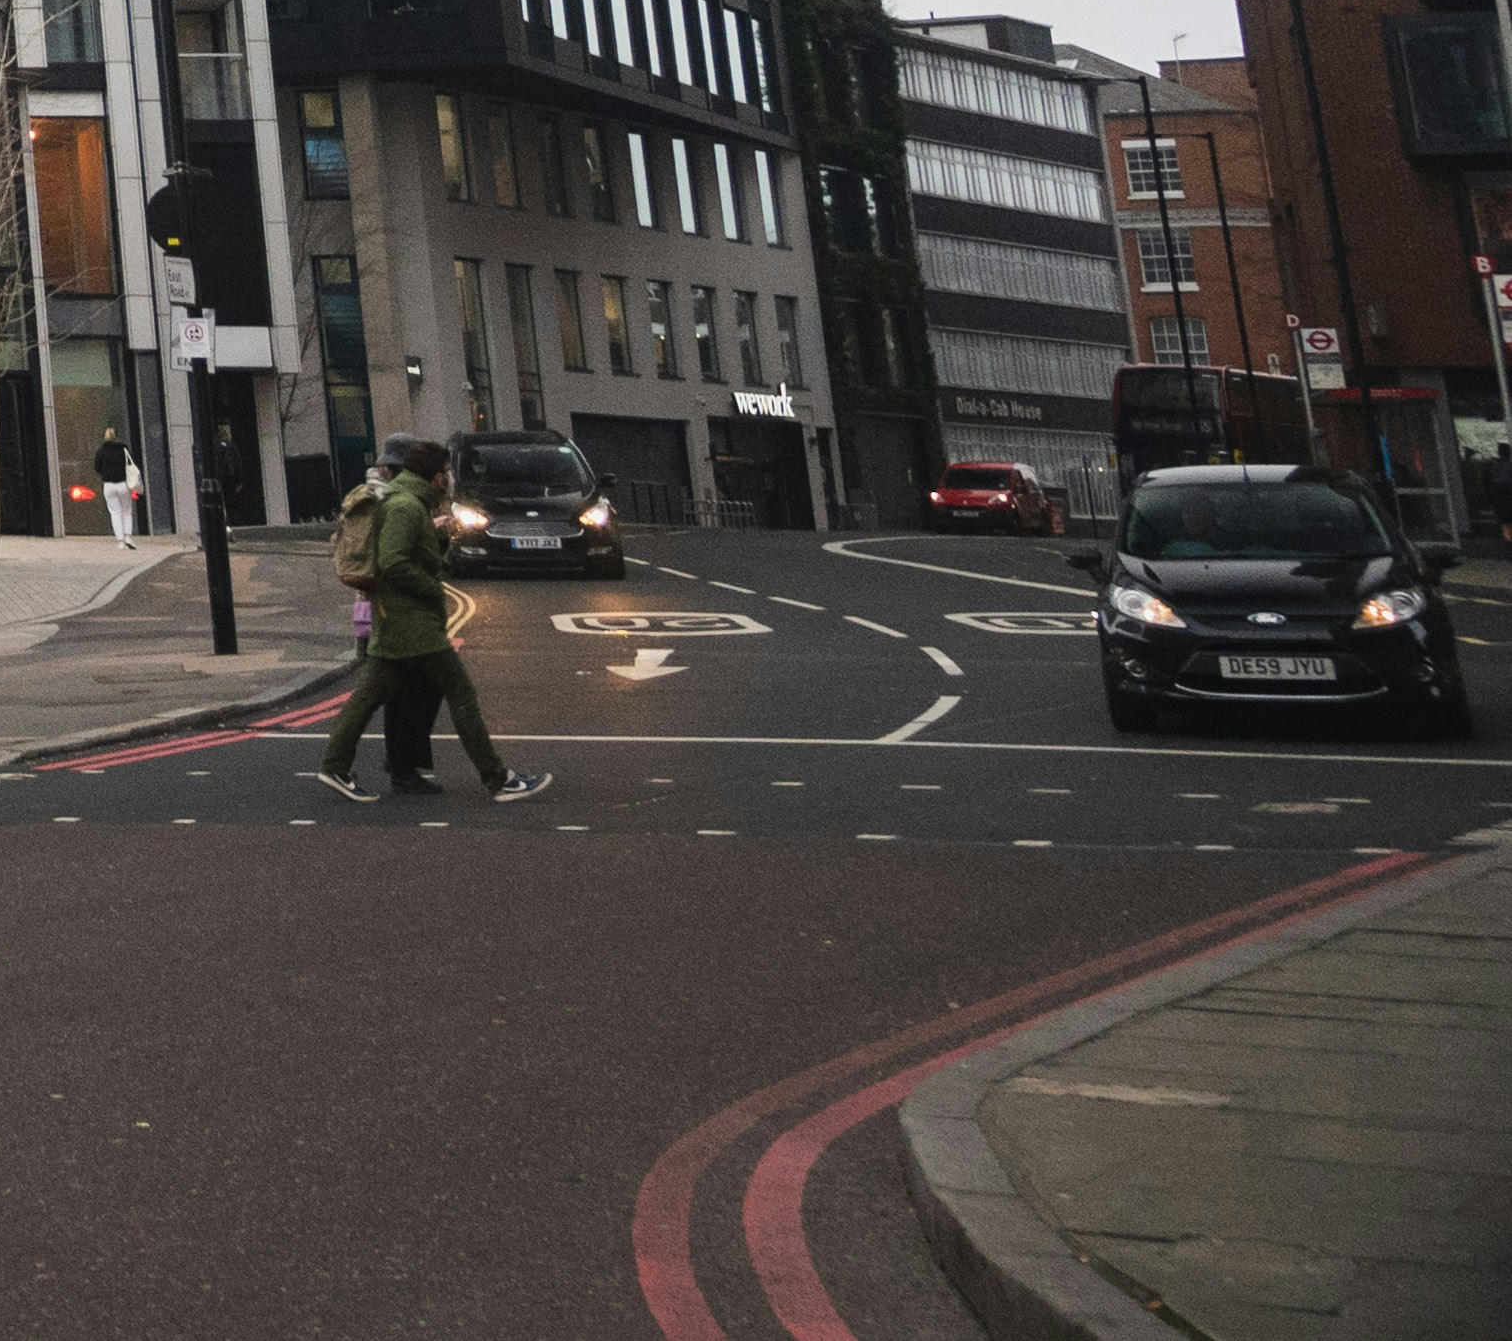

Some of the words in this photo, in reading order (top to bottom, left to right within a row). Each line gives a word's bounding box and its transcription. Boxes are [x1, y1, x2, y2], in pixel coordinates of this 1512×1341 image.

[1476, 256, 1491, 273] B
[1286, 314, 1299, 327] D
[734, 382, 795, 417] wework
[1229, 658, 1281, 674] DE59
[1287, 658, 1326, 675] JYU
